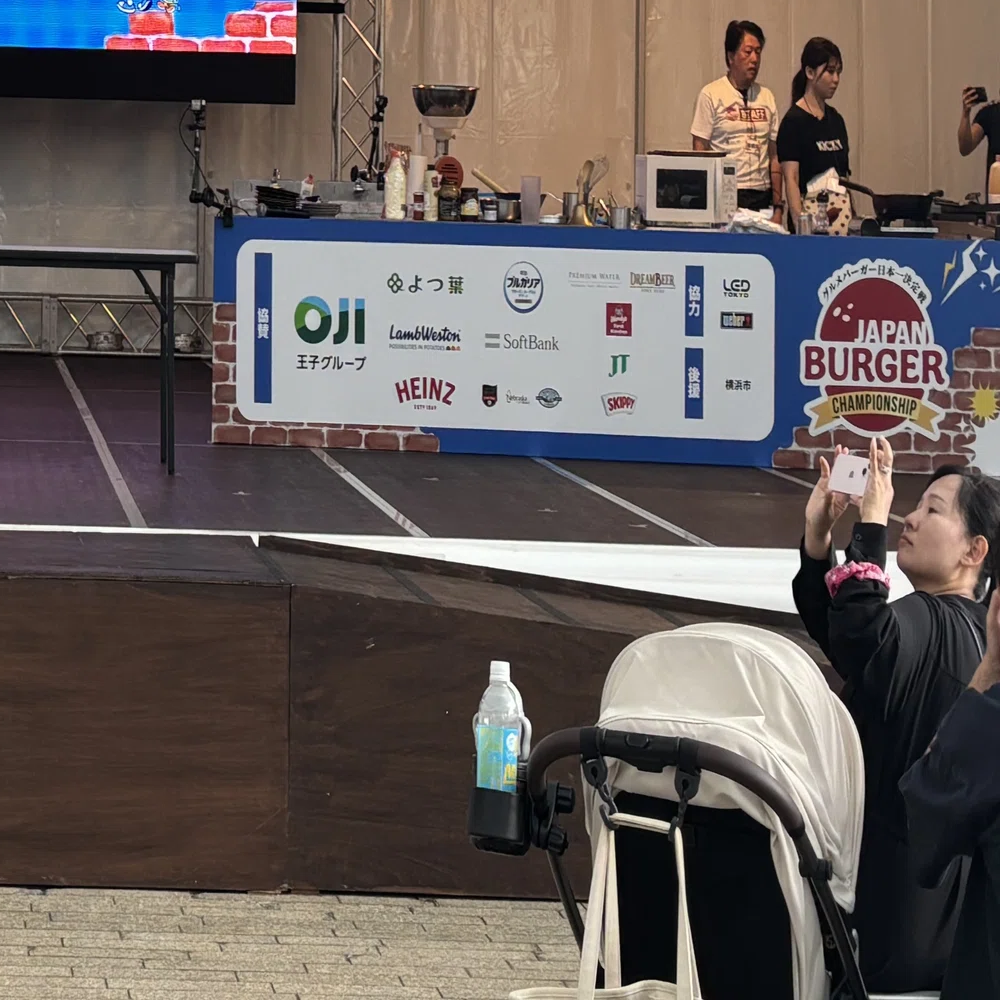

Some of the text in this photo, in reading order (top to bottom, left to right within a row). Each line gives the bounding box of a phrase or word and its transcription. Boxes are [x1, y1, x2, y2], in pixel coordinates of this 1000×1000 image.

[407, 275, 464, 294] よつ葉
[507, 276, 540, 288] ブルガリア
[723, 279, 750, 292] LED
[688, 285, 701, 317] 協力
[257, 308, 269, 339] 協賛
[294, 296, 365, 344] OJI
[503, 333, 559, 351] SoftBank
[853, 319, 928, 345] JAPAN
[296, 355, 367, 371] 王子グループ
[608, 354, 630, 377] JT
[804, 346, 946, 385] BURGER
[395, 377, 456, 406] HEINZ
[688, 366, 701, 398] 後援
[725, 379, 752, 391] 横浜市
[607, 396, 636, 411] SKIPPY
[831, 394, 918, 416] CHAMPIONSHIP
